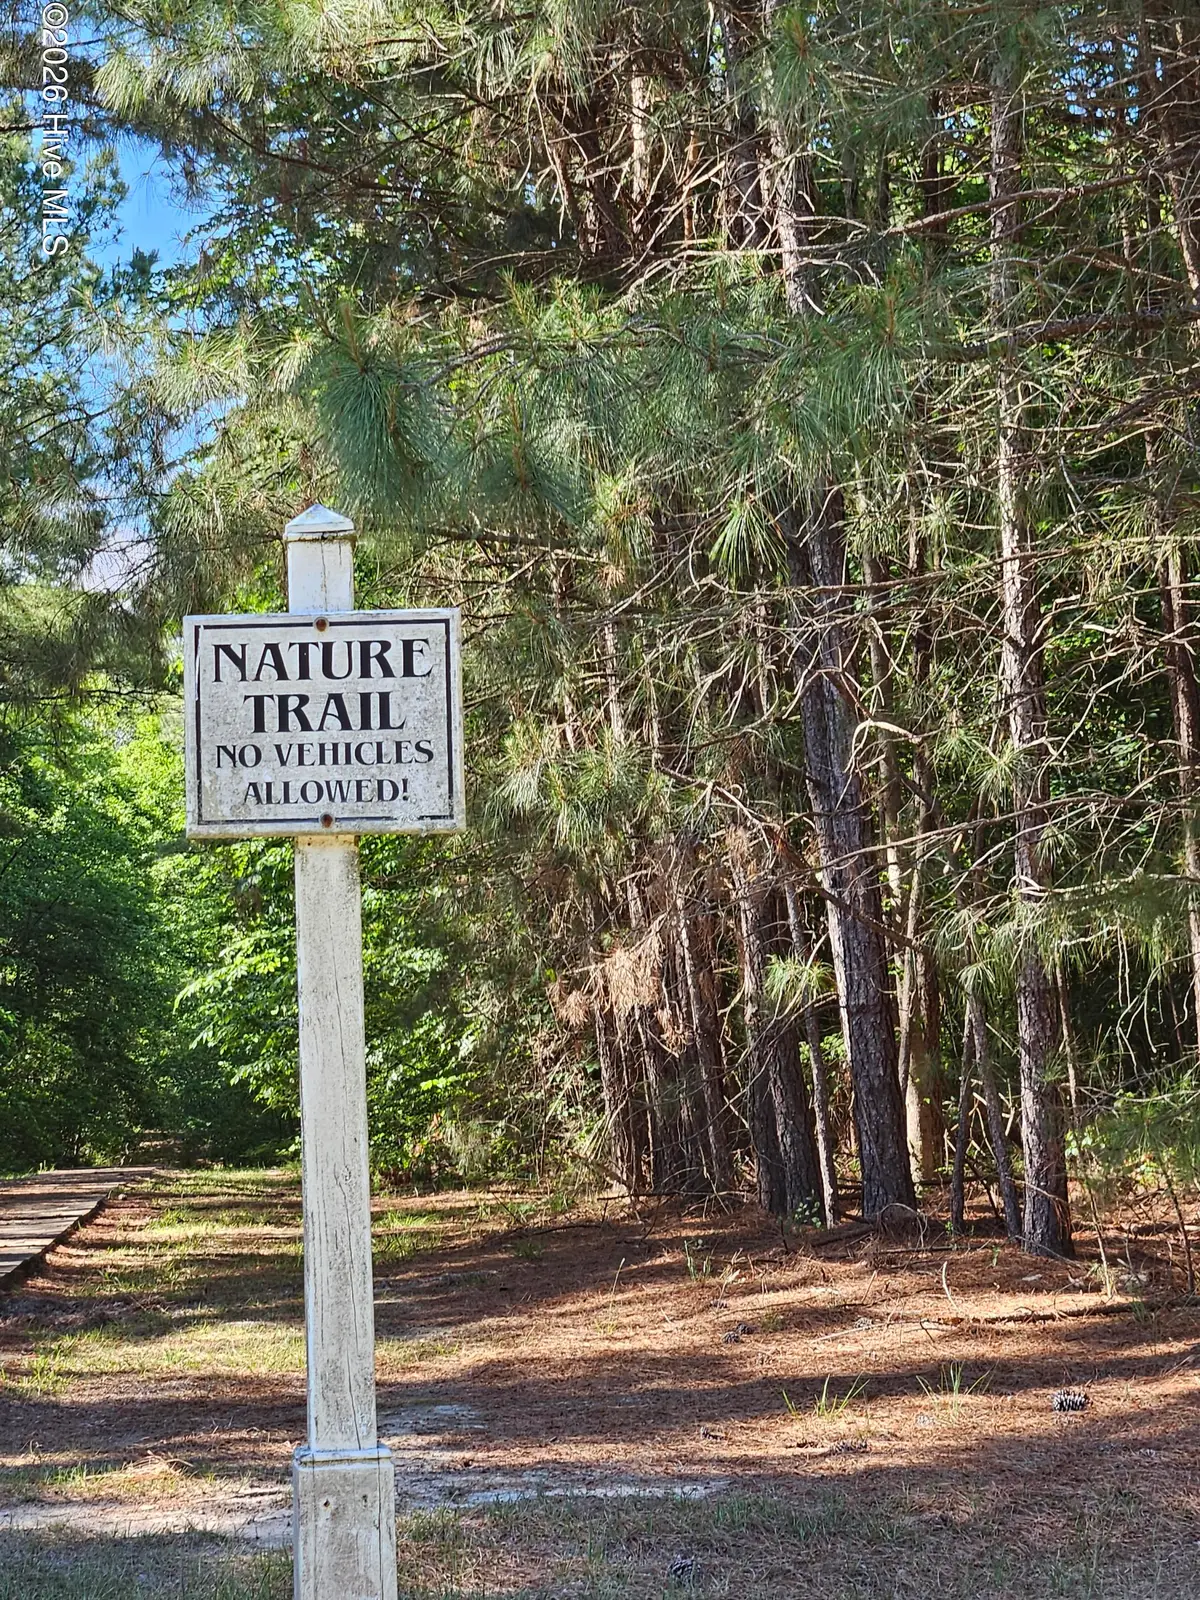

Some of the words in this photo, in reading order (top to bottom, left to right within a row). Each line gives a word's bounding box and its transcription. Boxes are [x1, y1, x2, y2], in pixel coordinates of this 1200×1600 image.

[212, 638, 434, 683] NATURE
[243, 691, 406, 733] TRAIL
[215, 743, 262, 768] NO
[274, 739, 434, 767] VEHICLES
[243, 778, 410, 805] ALLOWED!
